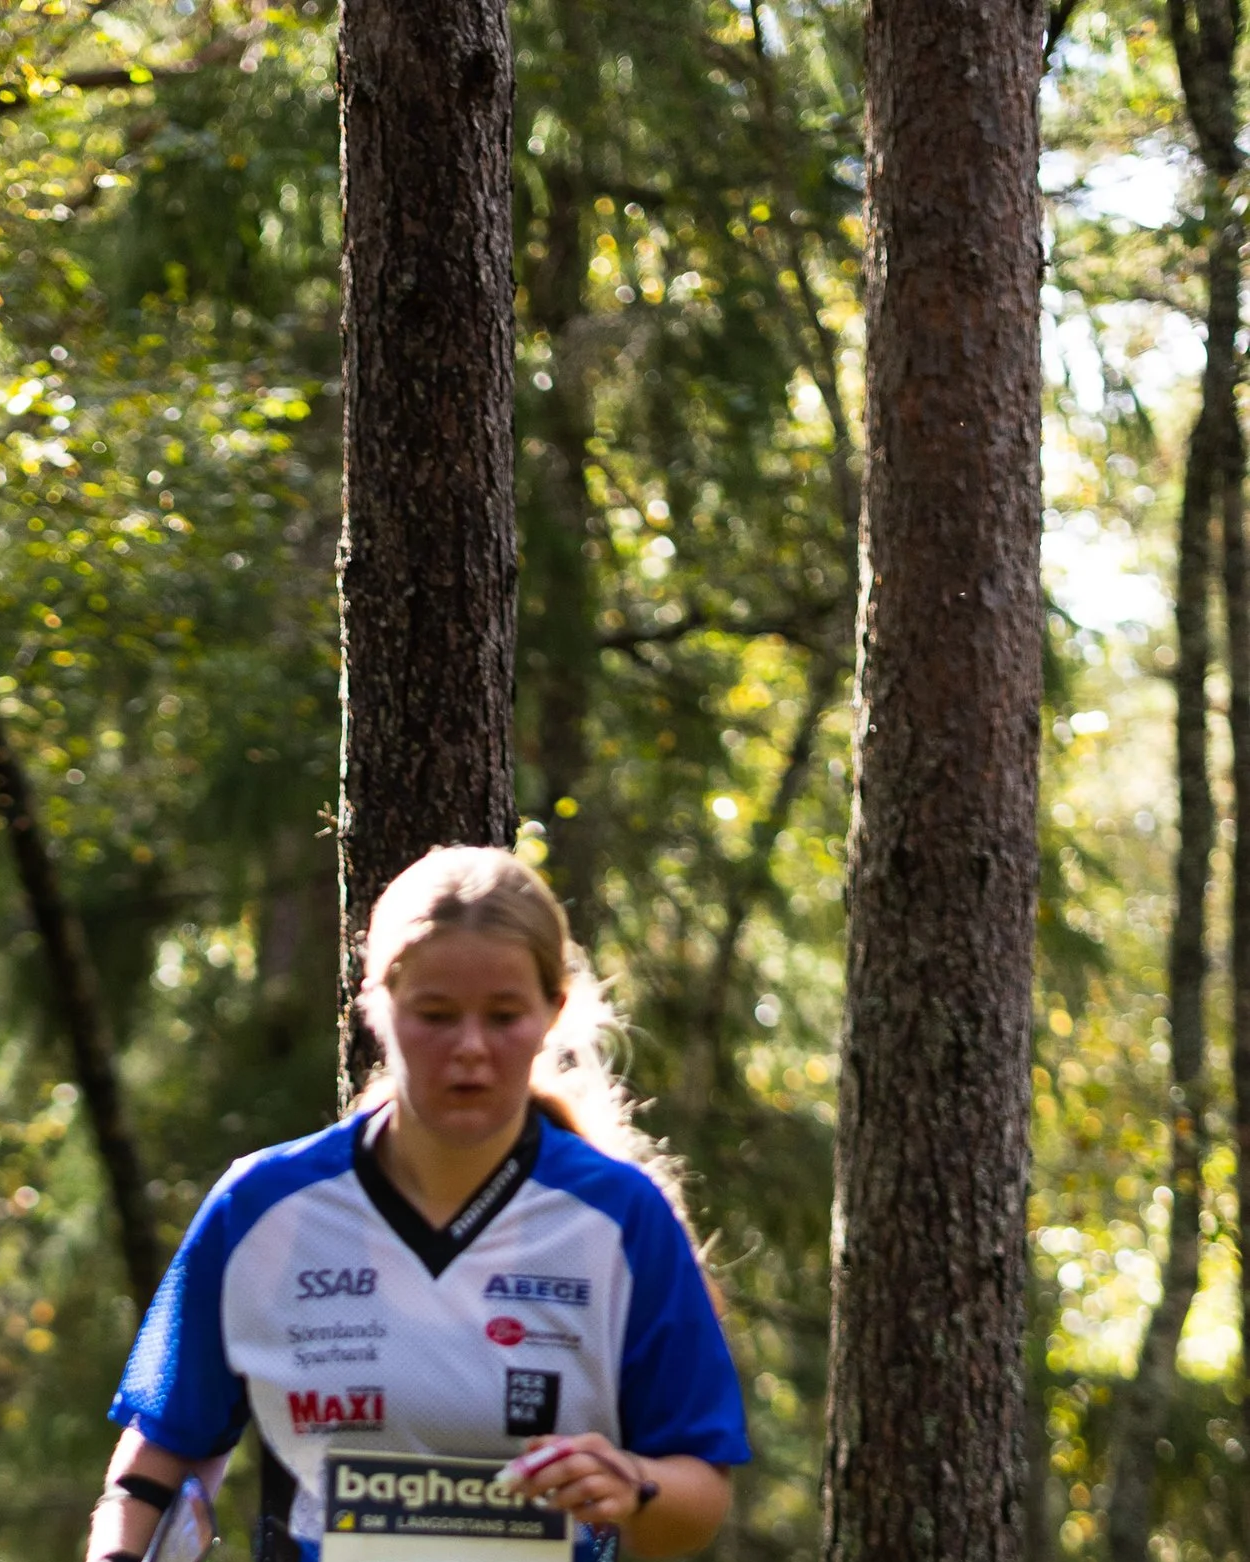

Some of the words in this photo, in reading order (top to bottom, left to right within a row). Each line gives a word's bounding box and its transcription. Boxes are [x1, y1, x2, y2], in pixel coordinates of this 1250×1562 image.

[296, 1267, 378, 1299] SSAB
[484, 1274, 591, 1302] ABECE
[288, 1390, 384, 1424] MAXI
